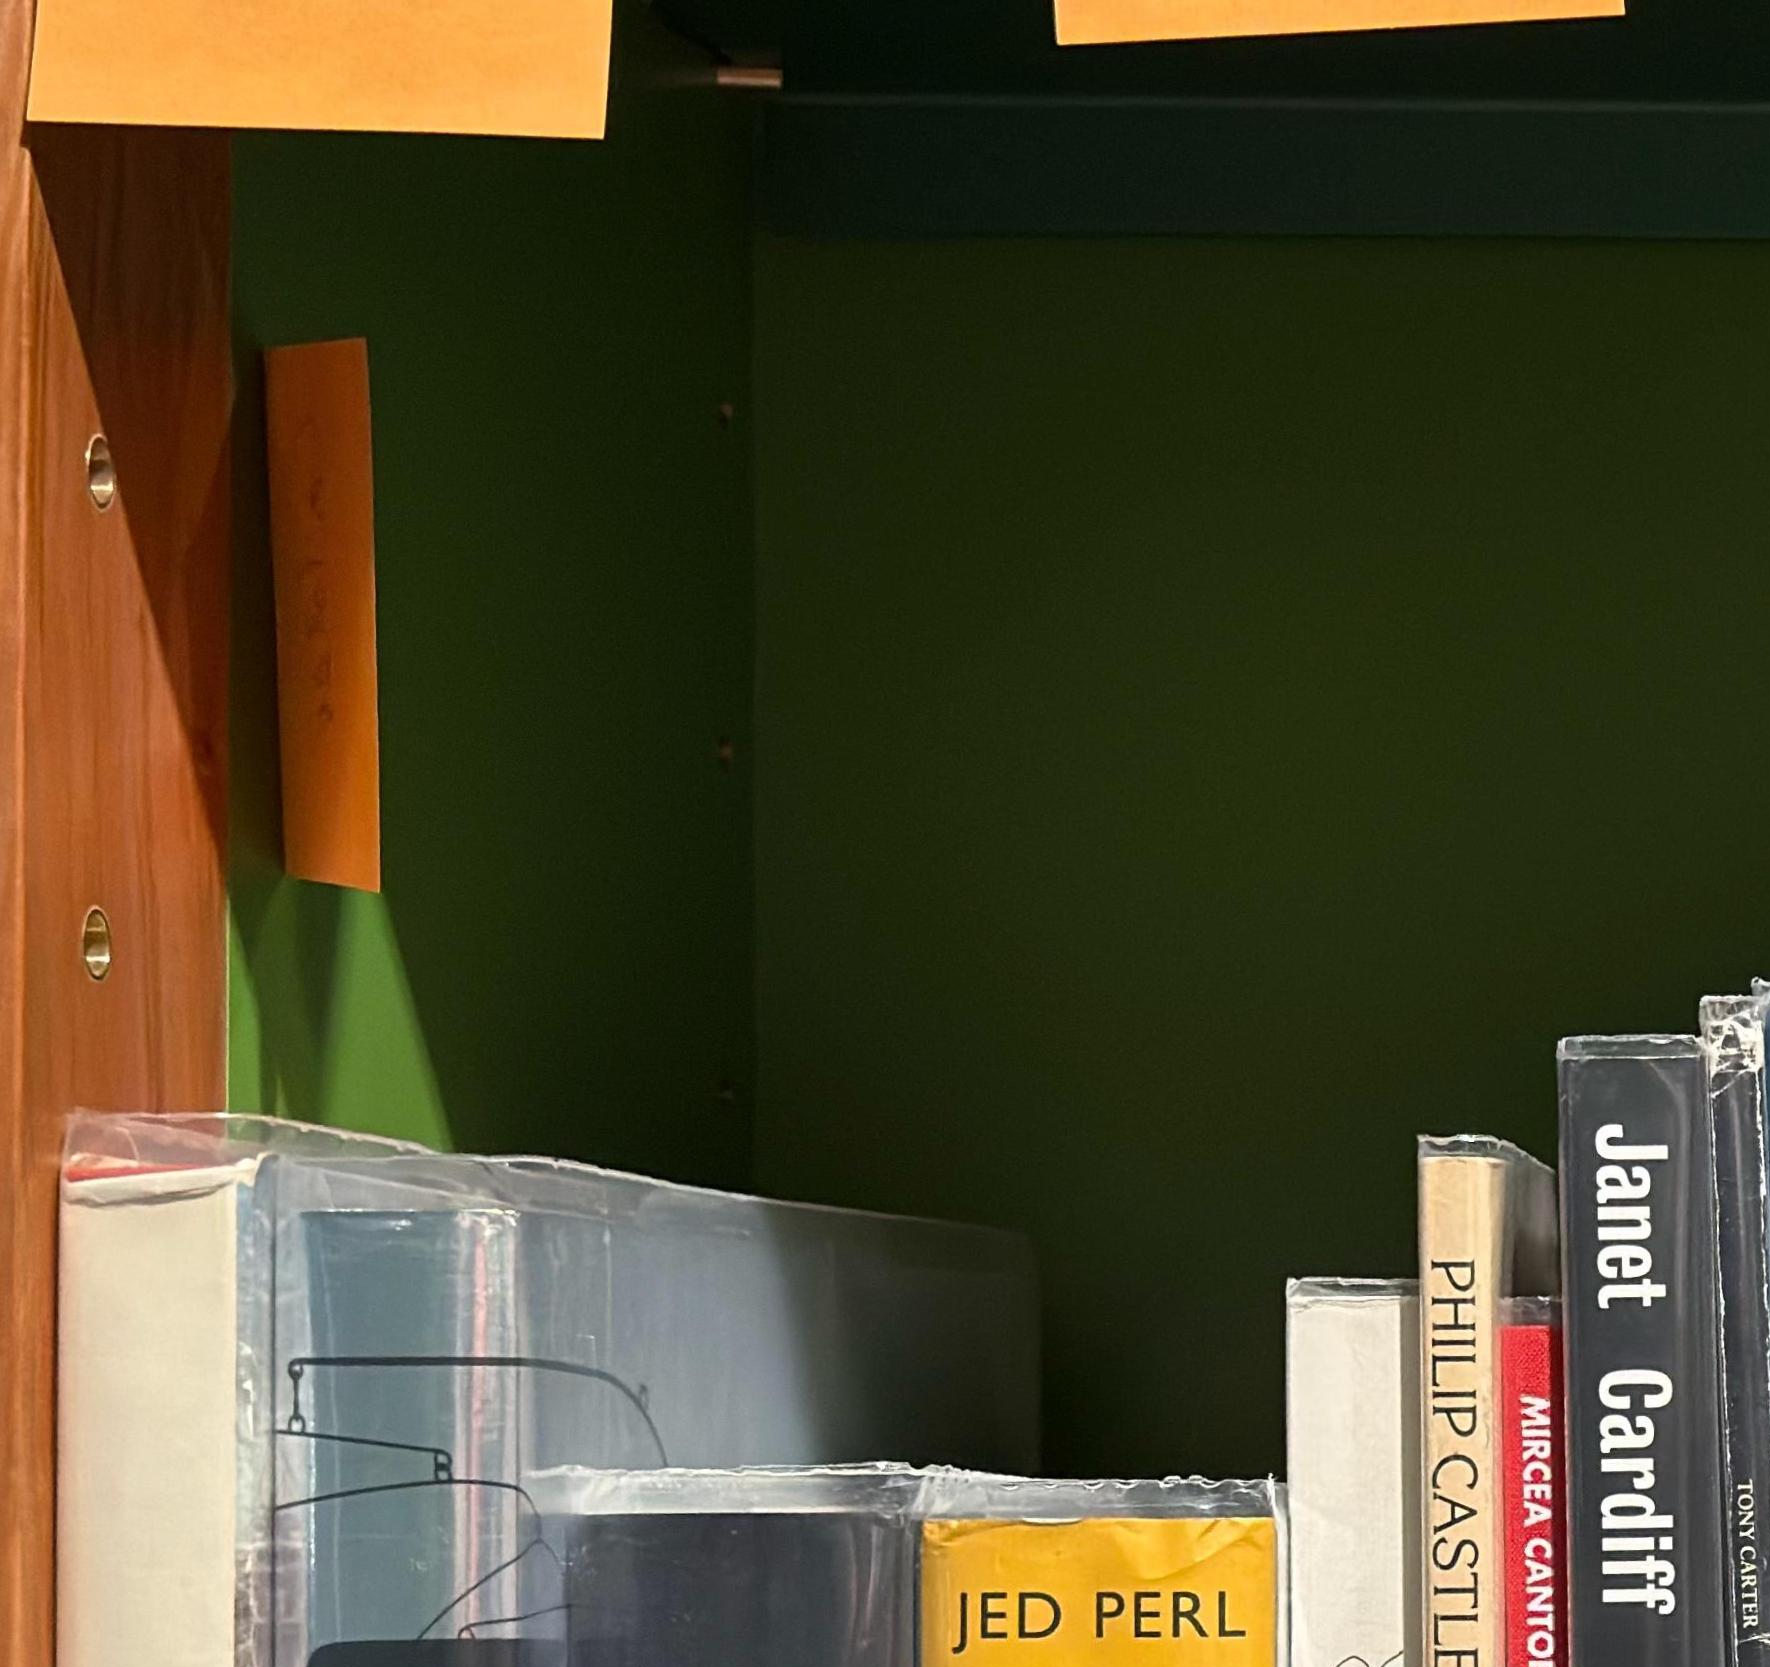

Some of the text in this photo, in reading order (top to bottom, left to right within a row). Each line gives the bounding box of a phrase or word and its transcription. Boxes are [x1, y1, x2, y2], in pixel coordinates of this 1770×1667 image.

[1431, 1259, 1477, 1438] PHILIP
[1595, 1123, 1677, 1615] Janet Cardiff
[1519, 1394, 1554, 1529] MIRCEA
[952, 1591, 1248, 1655] JED PERL
[1734, 1479, 1759, 1629] TONY CARTER
